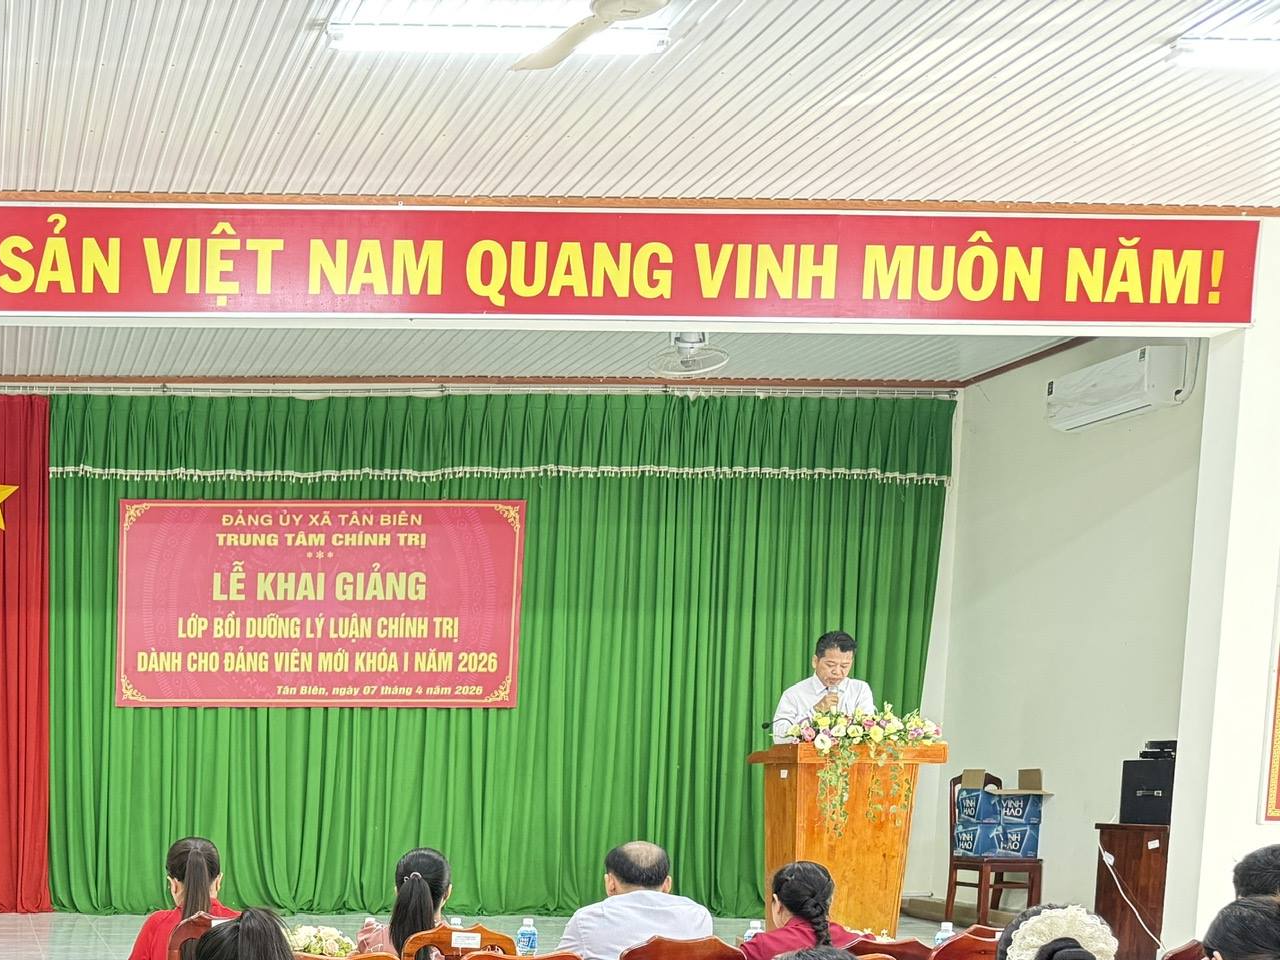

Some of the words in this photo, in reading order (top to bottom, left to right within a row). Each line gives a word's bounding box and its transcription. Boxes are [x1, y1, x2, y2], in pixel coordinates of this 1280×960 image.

[143, 221, 284, 307] VIỆT
[308, 238, 444, 296] NAM
[465, 239, 673, 306] QUANG
[694, 242, 838, 300] VINH
[862, 230, 1044, 302] MUÔN
[1065, 236, 1225, 305] NĂM!
[222, 509, 273, 526] ĐẢNG
[308, 511, 332, 526] XÃ
[338, 511, 374, 526] TÂN
[380, 511, 422, 526] BIÊN
[216, 533, 279, 546] TRUNG
[284, 531, 325, 546] TÂM
[331, 531, 391, 546] CHÍNH
[397, 533, 426, 549] TRỊ
[213, 560, 246, 601] LỄ
[257, 572, 325, 601] KHAI
[335, 562, 427, 601] GIẢNG
[177, 613, 208, 638] LỚP
[213, 610, 241, 638] BỒI
[246, 612, 301, 638] DƯỠNG
[305, 613, 325, 638] LÝ
[329, 613, 372, 643] LUẬN
[377, 613, 428, 638] CHÍNH
[433, 616, 459, 643] TRỊ
[137, 647, 182, 673] DÀNH
[187, 651, 220, 673] CHO
[223, 646, 269, 673] ĐẢNG
[274, 648, 312, 673] VIÊN
[318, 648, 349, 673] MỚI
[355, 647, 399, 673] KHÓA
[403, 651, 409, 673] I
[414, 648, 453, 673] NĂM
[458, 652, 498, 673] 2026
[277, 685, 297, 696] Tân
[332, 685, 360, 697] ngày
[363, 685, 377, 696] 07
[381, 685, 413, 697] tháng
[416, 685, 424, 696] 4
[426, 685, 451, 696] năm
[455, 685, 483, 696] 2026
